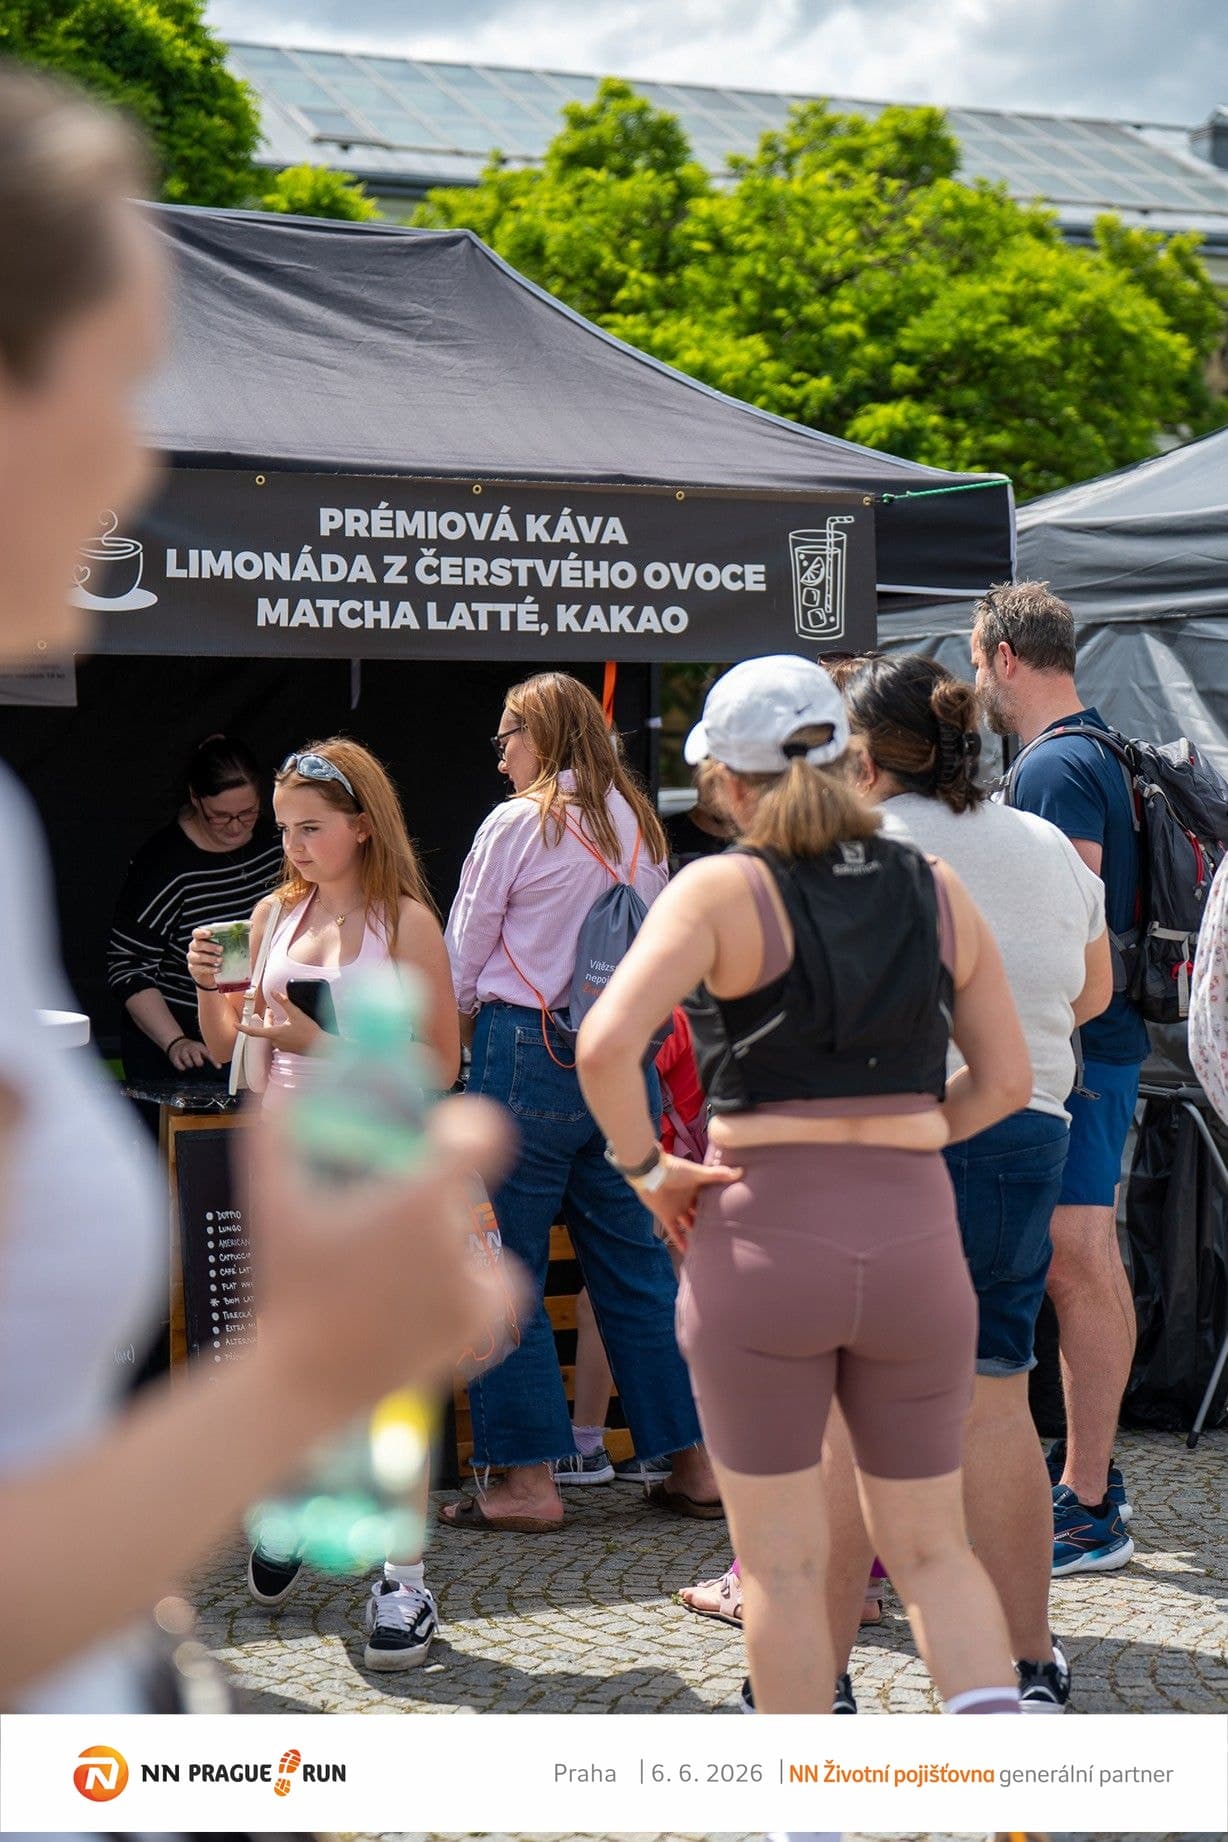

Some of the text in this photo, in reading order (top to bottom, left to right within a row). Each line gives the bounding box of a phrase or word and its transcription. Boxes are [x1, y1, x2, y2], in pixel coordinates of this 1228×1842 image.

[319, 500, 629, 545] PRÉMIOVÁ KÁVA
[166, 544, 767, 592] LIMONÁDA Z ČERSTVÉHO OVOCE
[256, 595, 689, 636] MATCHA LATTÉ, KAKAO
[590, 959, 616, 972] Vítězs
[585, 973, 610, 985] nepo
[218, 1224, 242, 1233] LUNGO
[218, 1238, 250, 1249] AMERICAN
